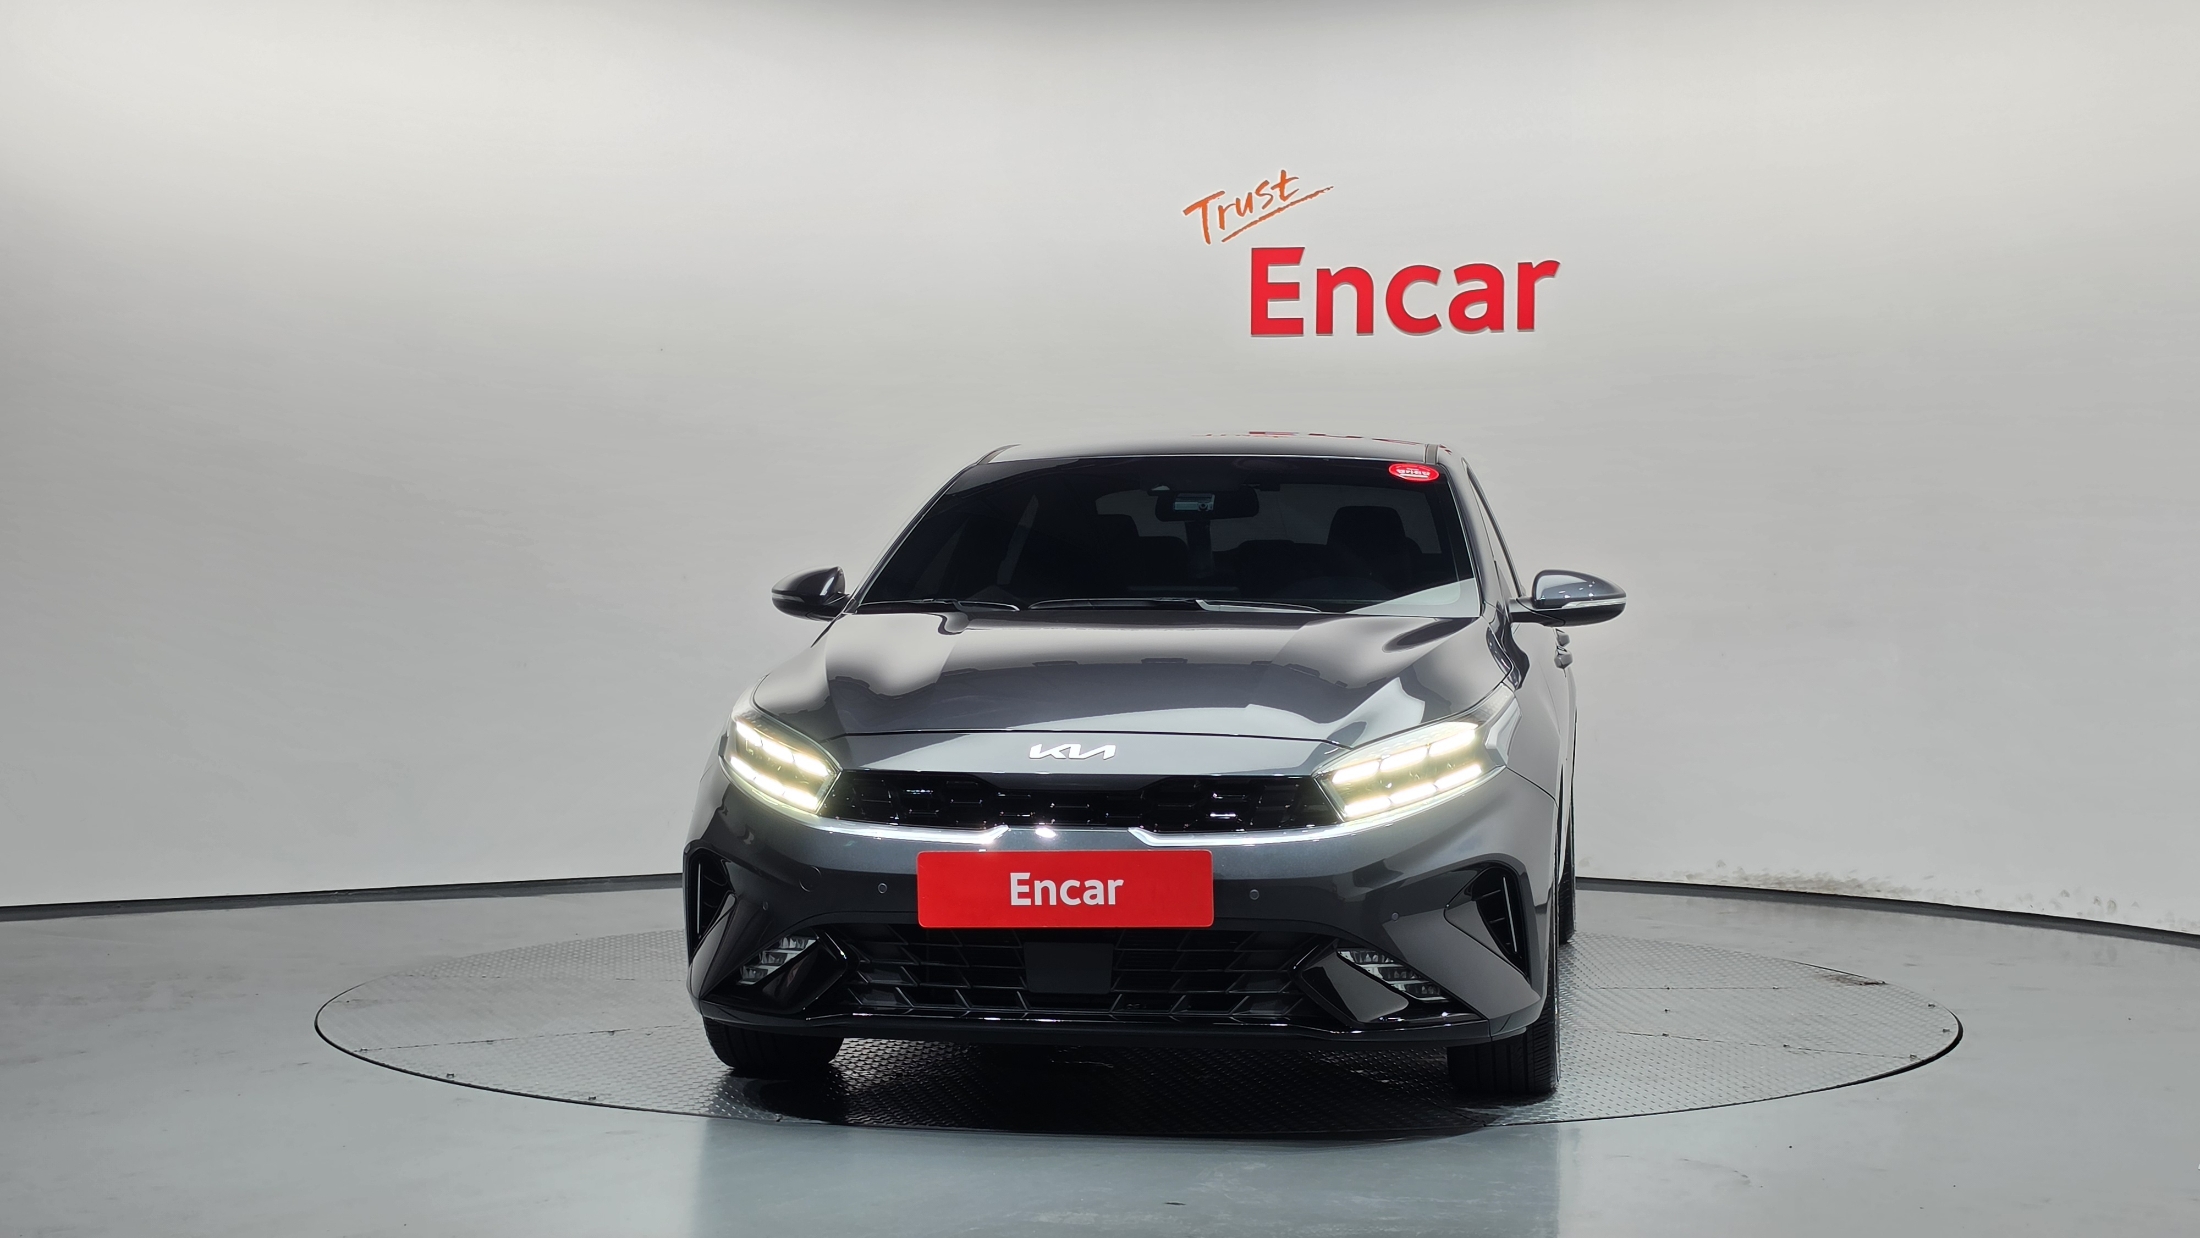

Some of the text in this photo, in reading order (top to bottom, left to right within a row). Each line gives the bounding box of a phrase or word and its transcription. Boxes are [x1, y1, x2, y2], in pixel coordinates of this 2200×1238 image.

[1183, 169, 1300, 245] Trust
[1251, 247, 1560, 336] Encar
[1010, 872, 1124, 906] Encar
